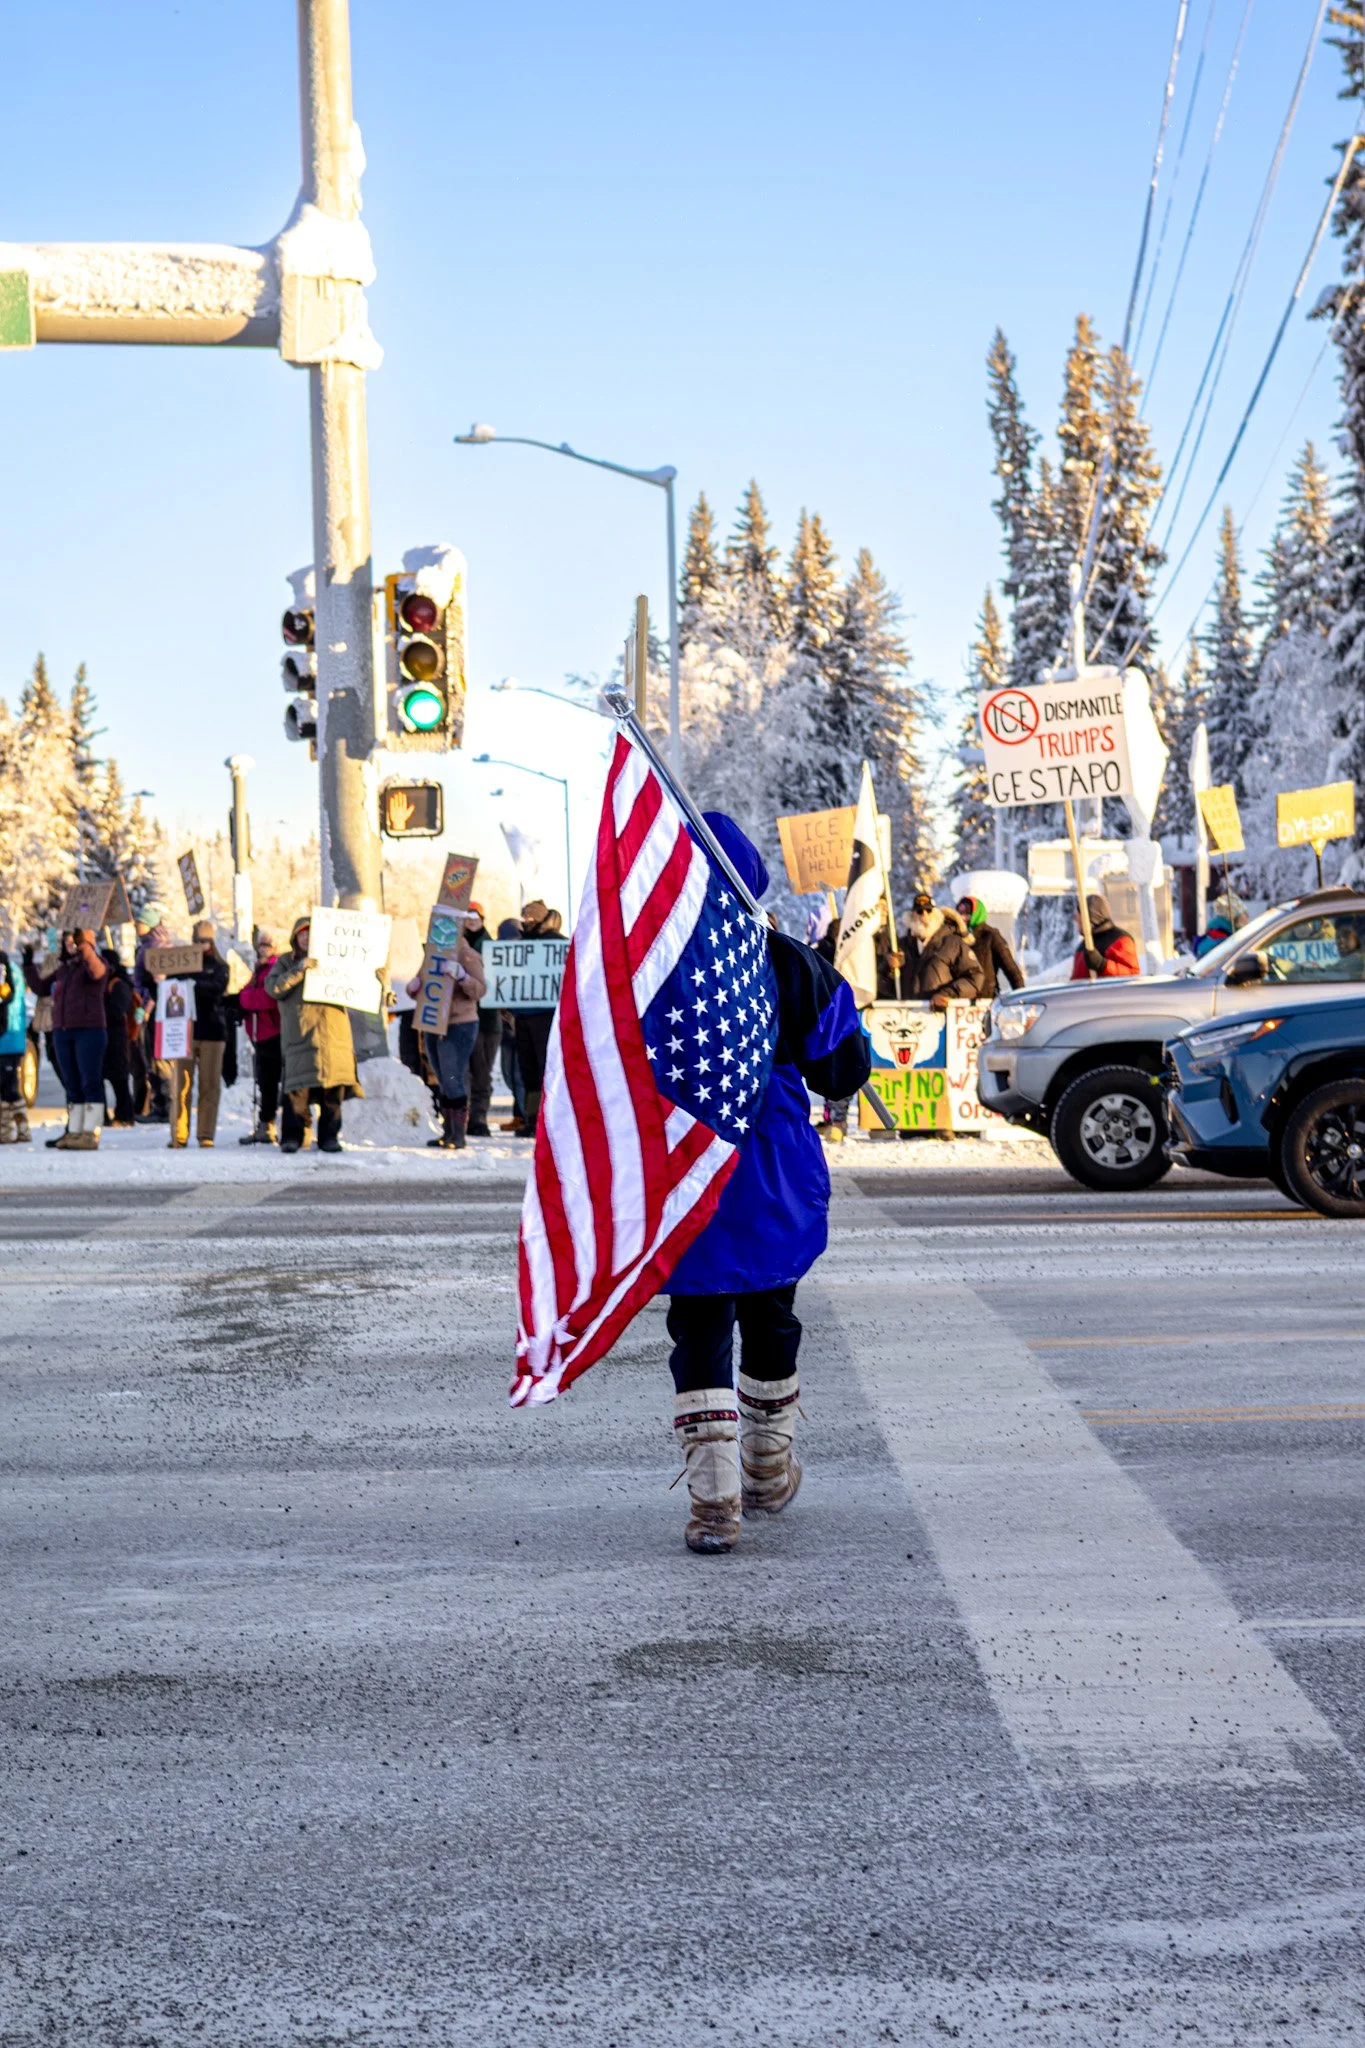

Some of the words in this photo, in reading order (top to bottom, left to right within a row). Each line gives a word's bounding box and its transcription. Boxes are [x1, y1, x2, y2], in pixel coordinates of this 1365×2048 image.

[992, 701, 1029, 734] ICE
[1044, 693, 1123, 722] DISMANTLE
[992, 761, 1121, 803] GESTAPO
[804, 817, 839, 841] ICE
[801, 840, 836, 861] MELT
[809, 856, 844, 873] HELL
[149, 951, 201, 969] RESIST
[492, 944, 535, 967] STOP
[1272, 945, 1298, 961] NO
[420, 955, 447, 1026] ICE
[495, 973, 562, 1002] KILLIN
